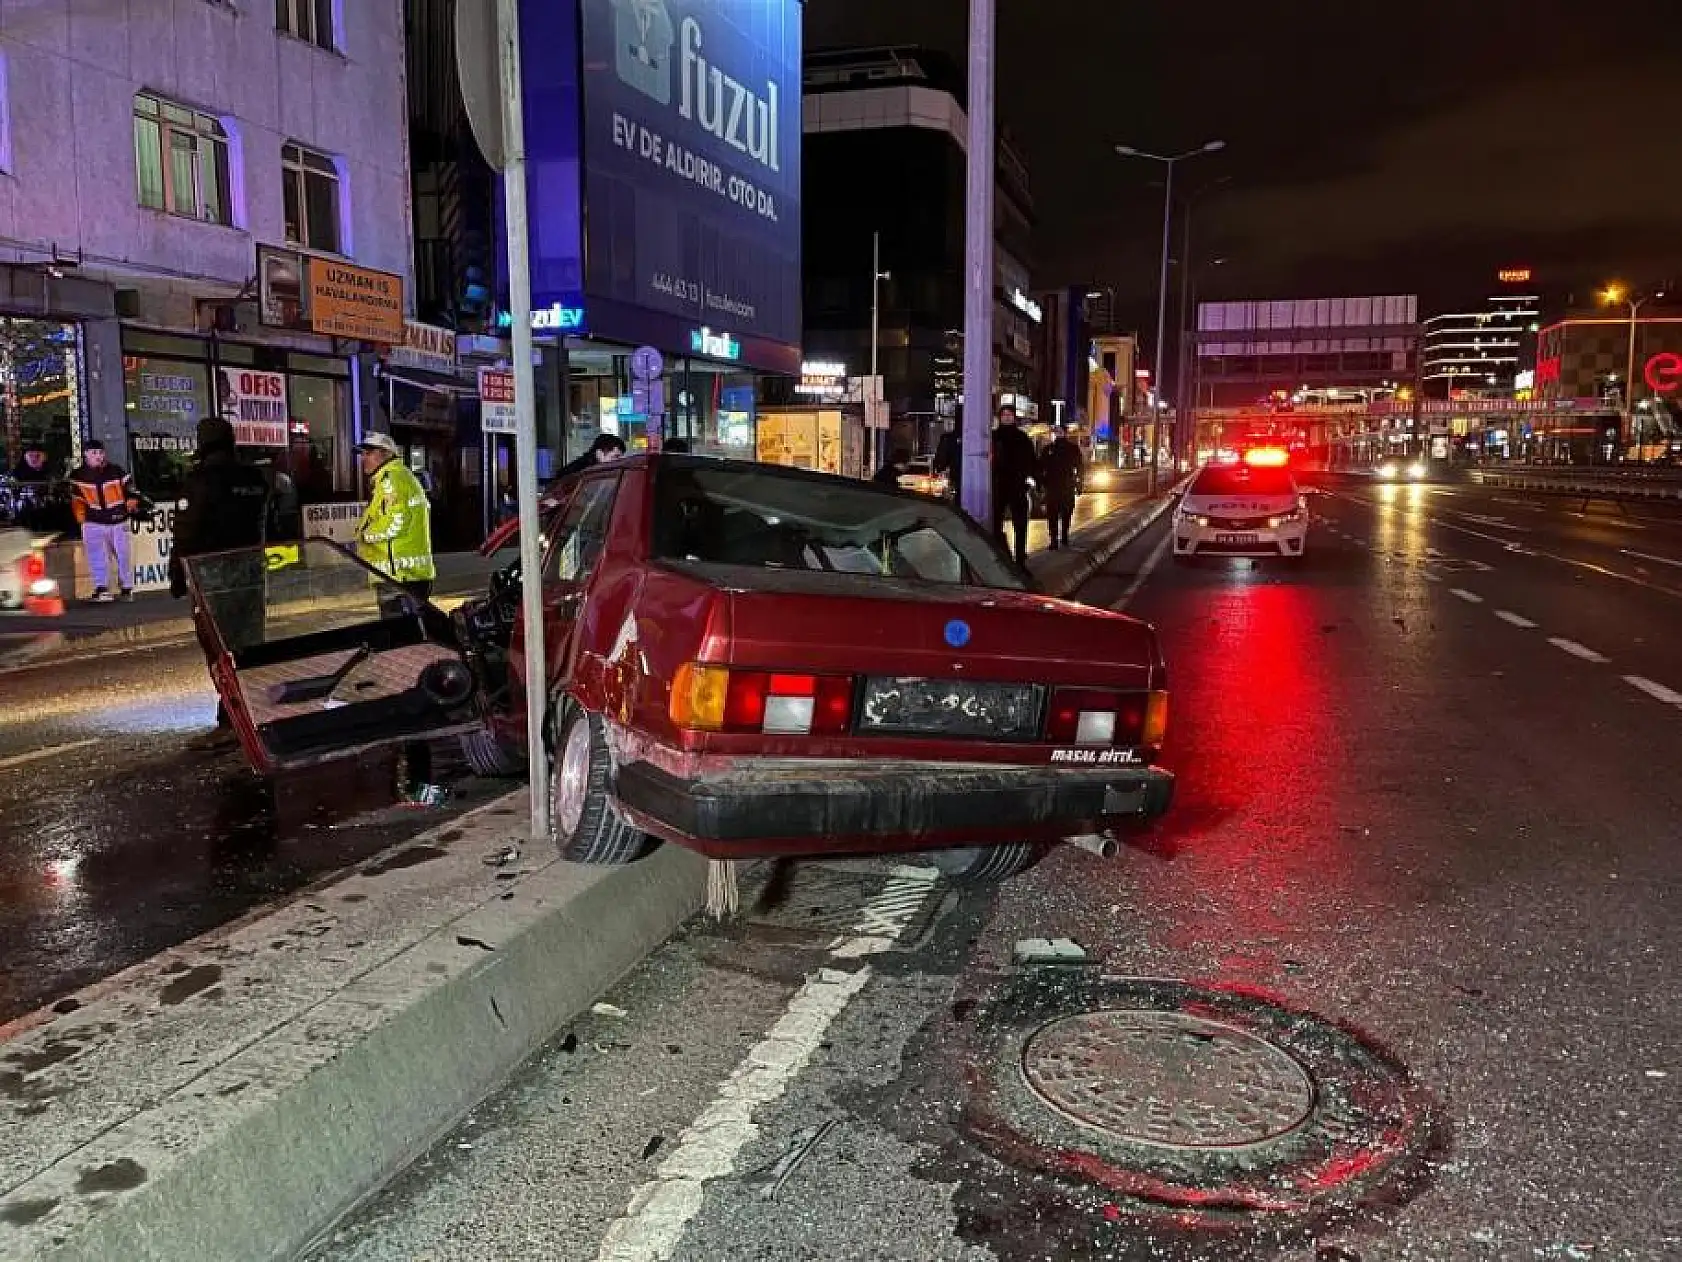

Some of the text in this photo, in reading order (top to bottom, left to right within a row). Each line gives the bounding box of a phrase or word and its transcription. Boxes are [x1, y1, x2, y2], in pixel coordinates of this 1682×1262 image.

[679, 15, 779, 172] fuzul
[612, 112, 779, 222] EV DE ALDIRIR. OTO DA.
